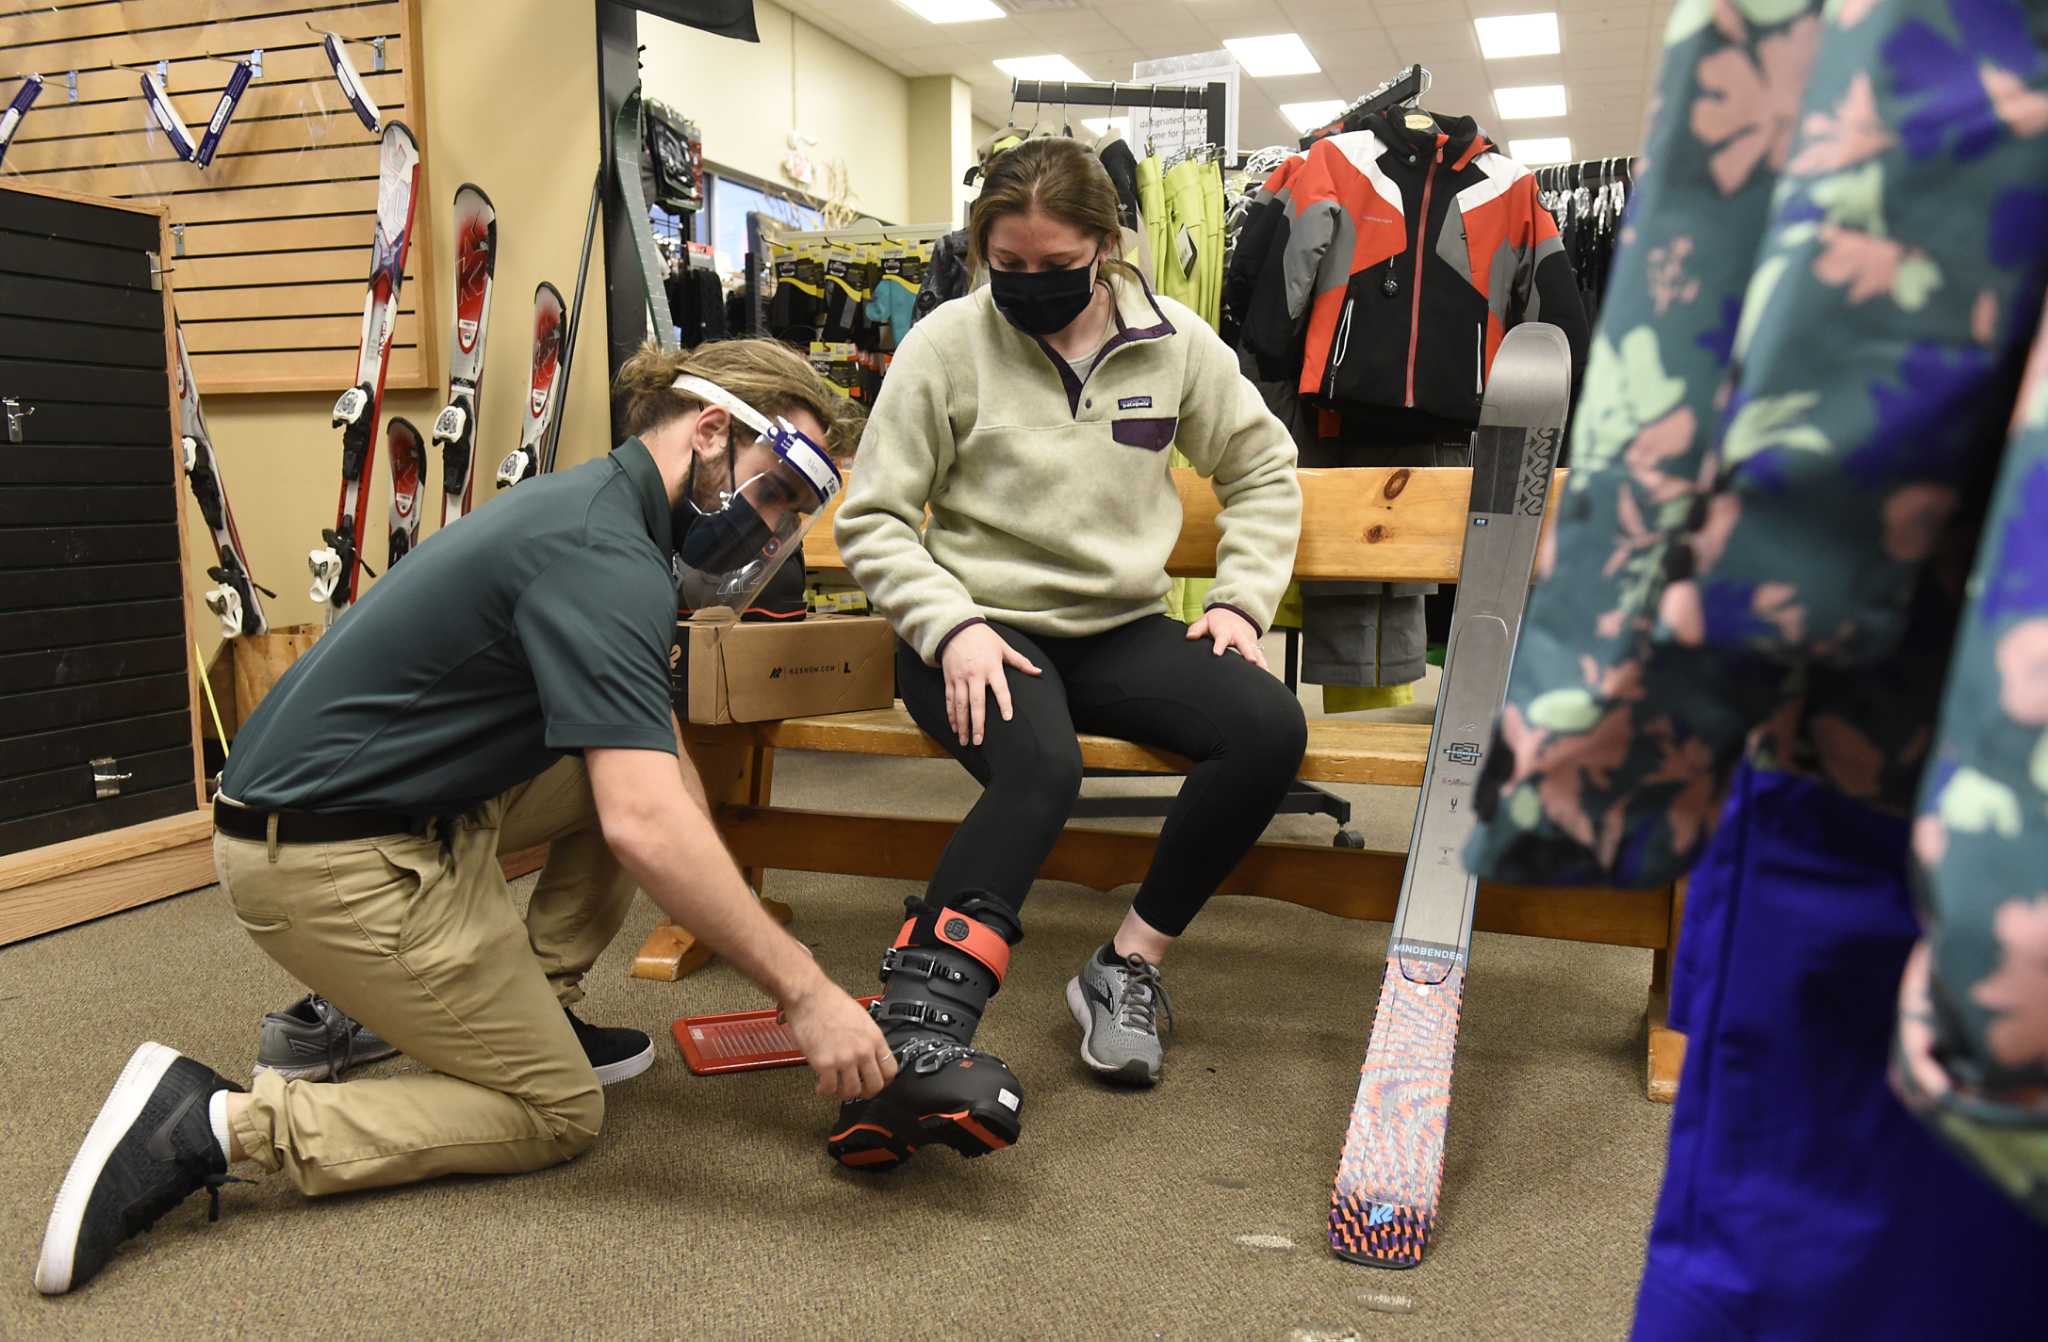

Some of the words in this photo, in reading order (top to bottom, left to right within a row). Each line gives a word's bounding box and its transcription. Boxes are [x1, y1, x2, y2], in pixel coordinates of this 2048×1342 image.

[843, 661, 852, 674] L
[1393, 943, 1464, 961] MINDBENDER
[1368, 1203, 1394, 1227] K2
